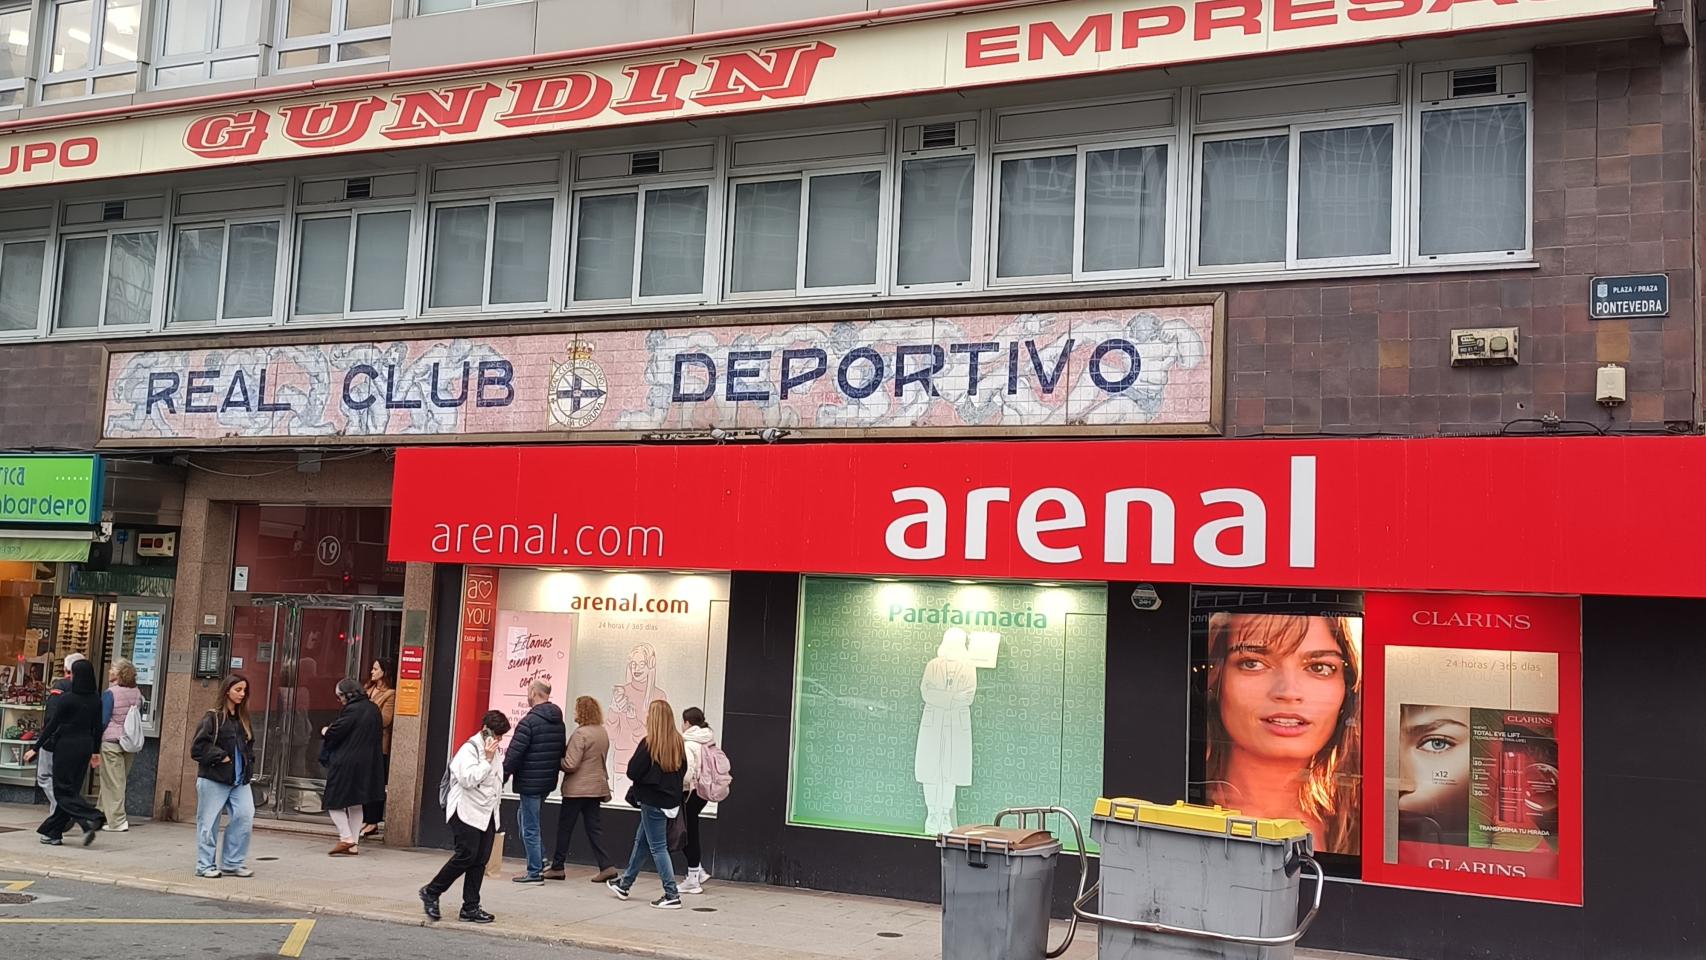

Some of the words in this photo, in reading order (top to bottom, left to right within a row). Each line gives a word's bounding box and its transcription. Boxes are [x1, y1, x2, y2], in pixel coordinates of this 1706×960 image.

[182, 41, 837, 158] GUNDIN
[1596, 300, 1662, 314] PONTEVEDRA
[145, 367, 292, 415] REAL
[341, 358, 516, 410] CLUB
[672, 337, 1143, 403] DEPORTIVO
[884, 455, 1317, 569] arenal
[431, 513, 665, 557] arenal.com
[320, 541, 338, 560] 19
[571, 593, 689, 614] arenal.com
[466, 608, 491, 625] YOU
[608, 622, 624, 630] horas
[889, 603, 1047, 629] Parafarmacia
[1411, 610, 1531, 630] CLARINS
[512, 633, 553, 653] Estamos
[508, 654, 543, 672] siempre
[1446, 659, 1458, 668] 24
[1462, 660, 1488, 670] horas
[1499, 662, 1518, 671] 365
[1507, 715, 1552, 725] CLARINS
[1480, 825, 1518, 833] TRANSFORMA
[1428, 858, 1526, 878] CLARINS
